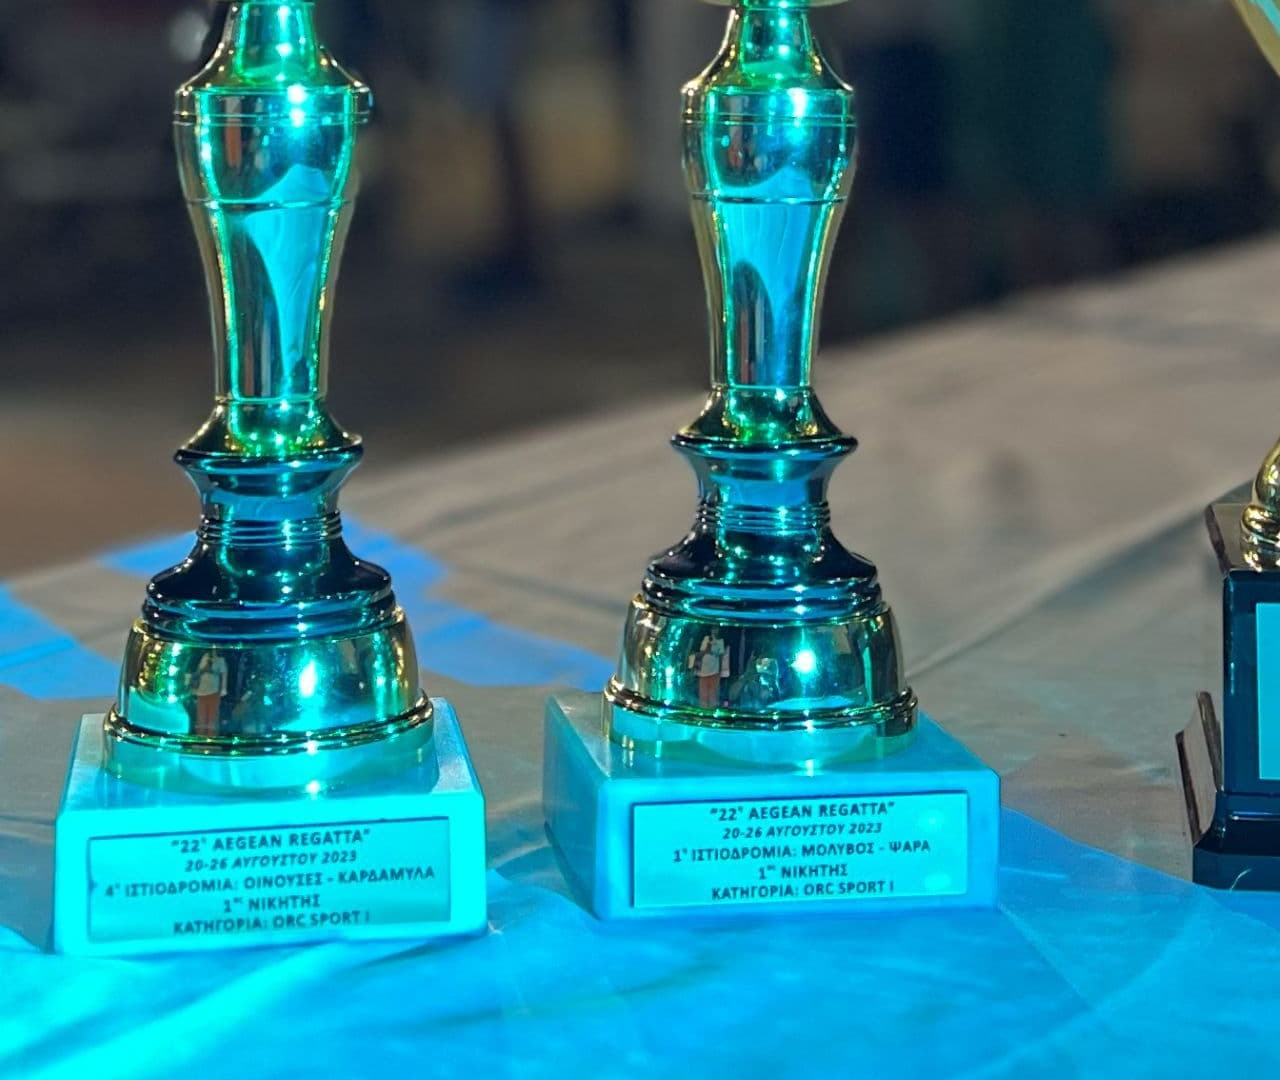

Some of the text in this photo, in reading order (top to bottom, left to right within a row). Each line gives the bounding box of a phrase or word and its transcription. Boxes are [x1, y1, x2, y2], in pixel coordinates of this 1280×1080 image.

[748, 805, 812, 820] AEGEAN
[722, 822, 882, 839] 20-26 ΑΥΓΟΥΣΤΟΥ 2023
[212, 834, 282, 852] AEGEAN
[802, 842, 874, 856] ΜΟΛΥΒΟΣ
[888, 840, 931, 853] ΨΑΡΑ
[185, 857, 227, 872] 20-26
[321, 850, 357, 864] 2023
[338, 866, 435, 884] ΚΑΡΔΑΜΥΛΑ
[781, 864, 848, 879] ΝΙΚΗΤΗΣ
[711, 884, 798, 900] ΚΑΤΗΓΟΡΙΑ:
[803, 882, 834, 896] ORC
[838, 880, 886, 894] SPORT
[272, 913, 305, 928] ORC
[310, 910, 360, 925] SPORT
